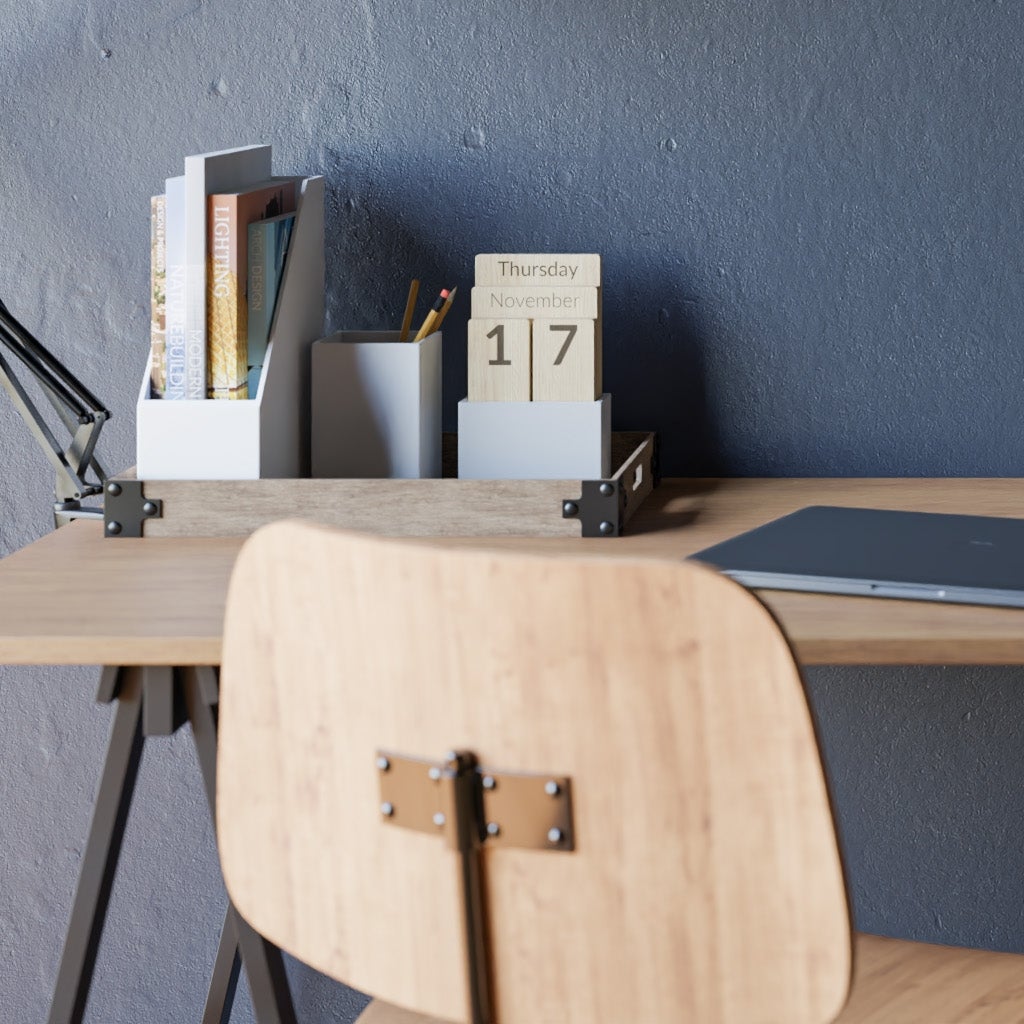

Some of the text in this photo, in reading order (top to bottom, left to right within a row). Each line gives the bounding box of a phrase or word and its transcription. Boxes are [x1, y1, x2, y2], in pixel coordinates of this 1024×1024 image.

[214, 206, 230, 298] LIGHTING
[498, 261, 579, 279] Thursday
[251, 265, 263, 311] DESIGN
[490, 293, 580, 309] November
[188, 329, 202, 398] MODERN
